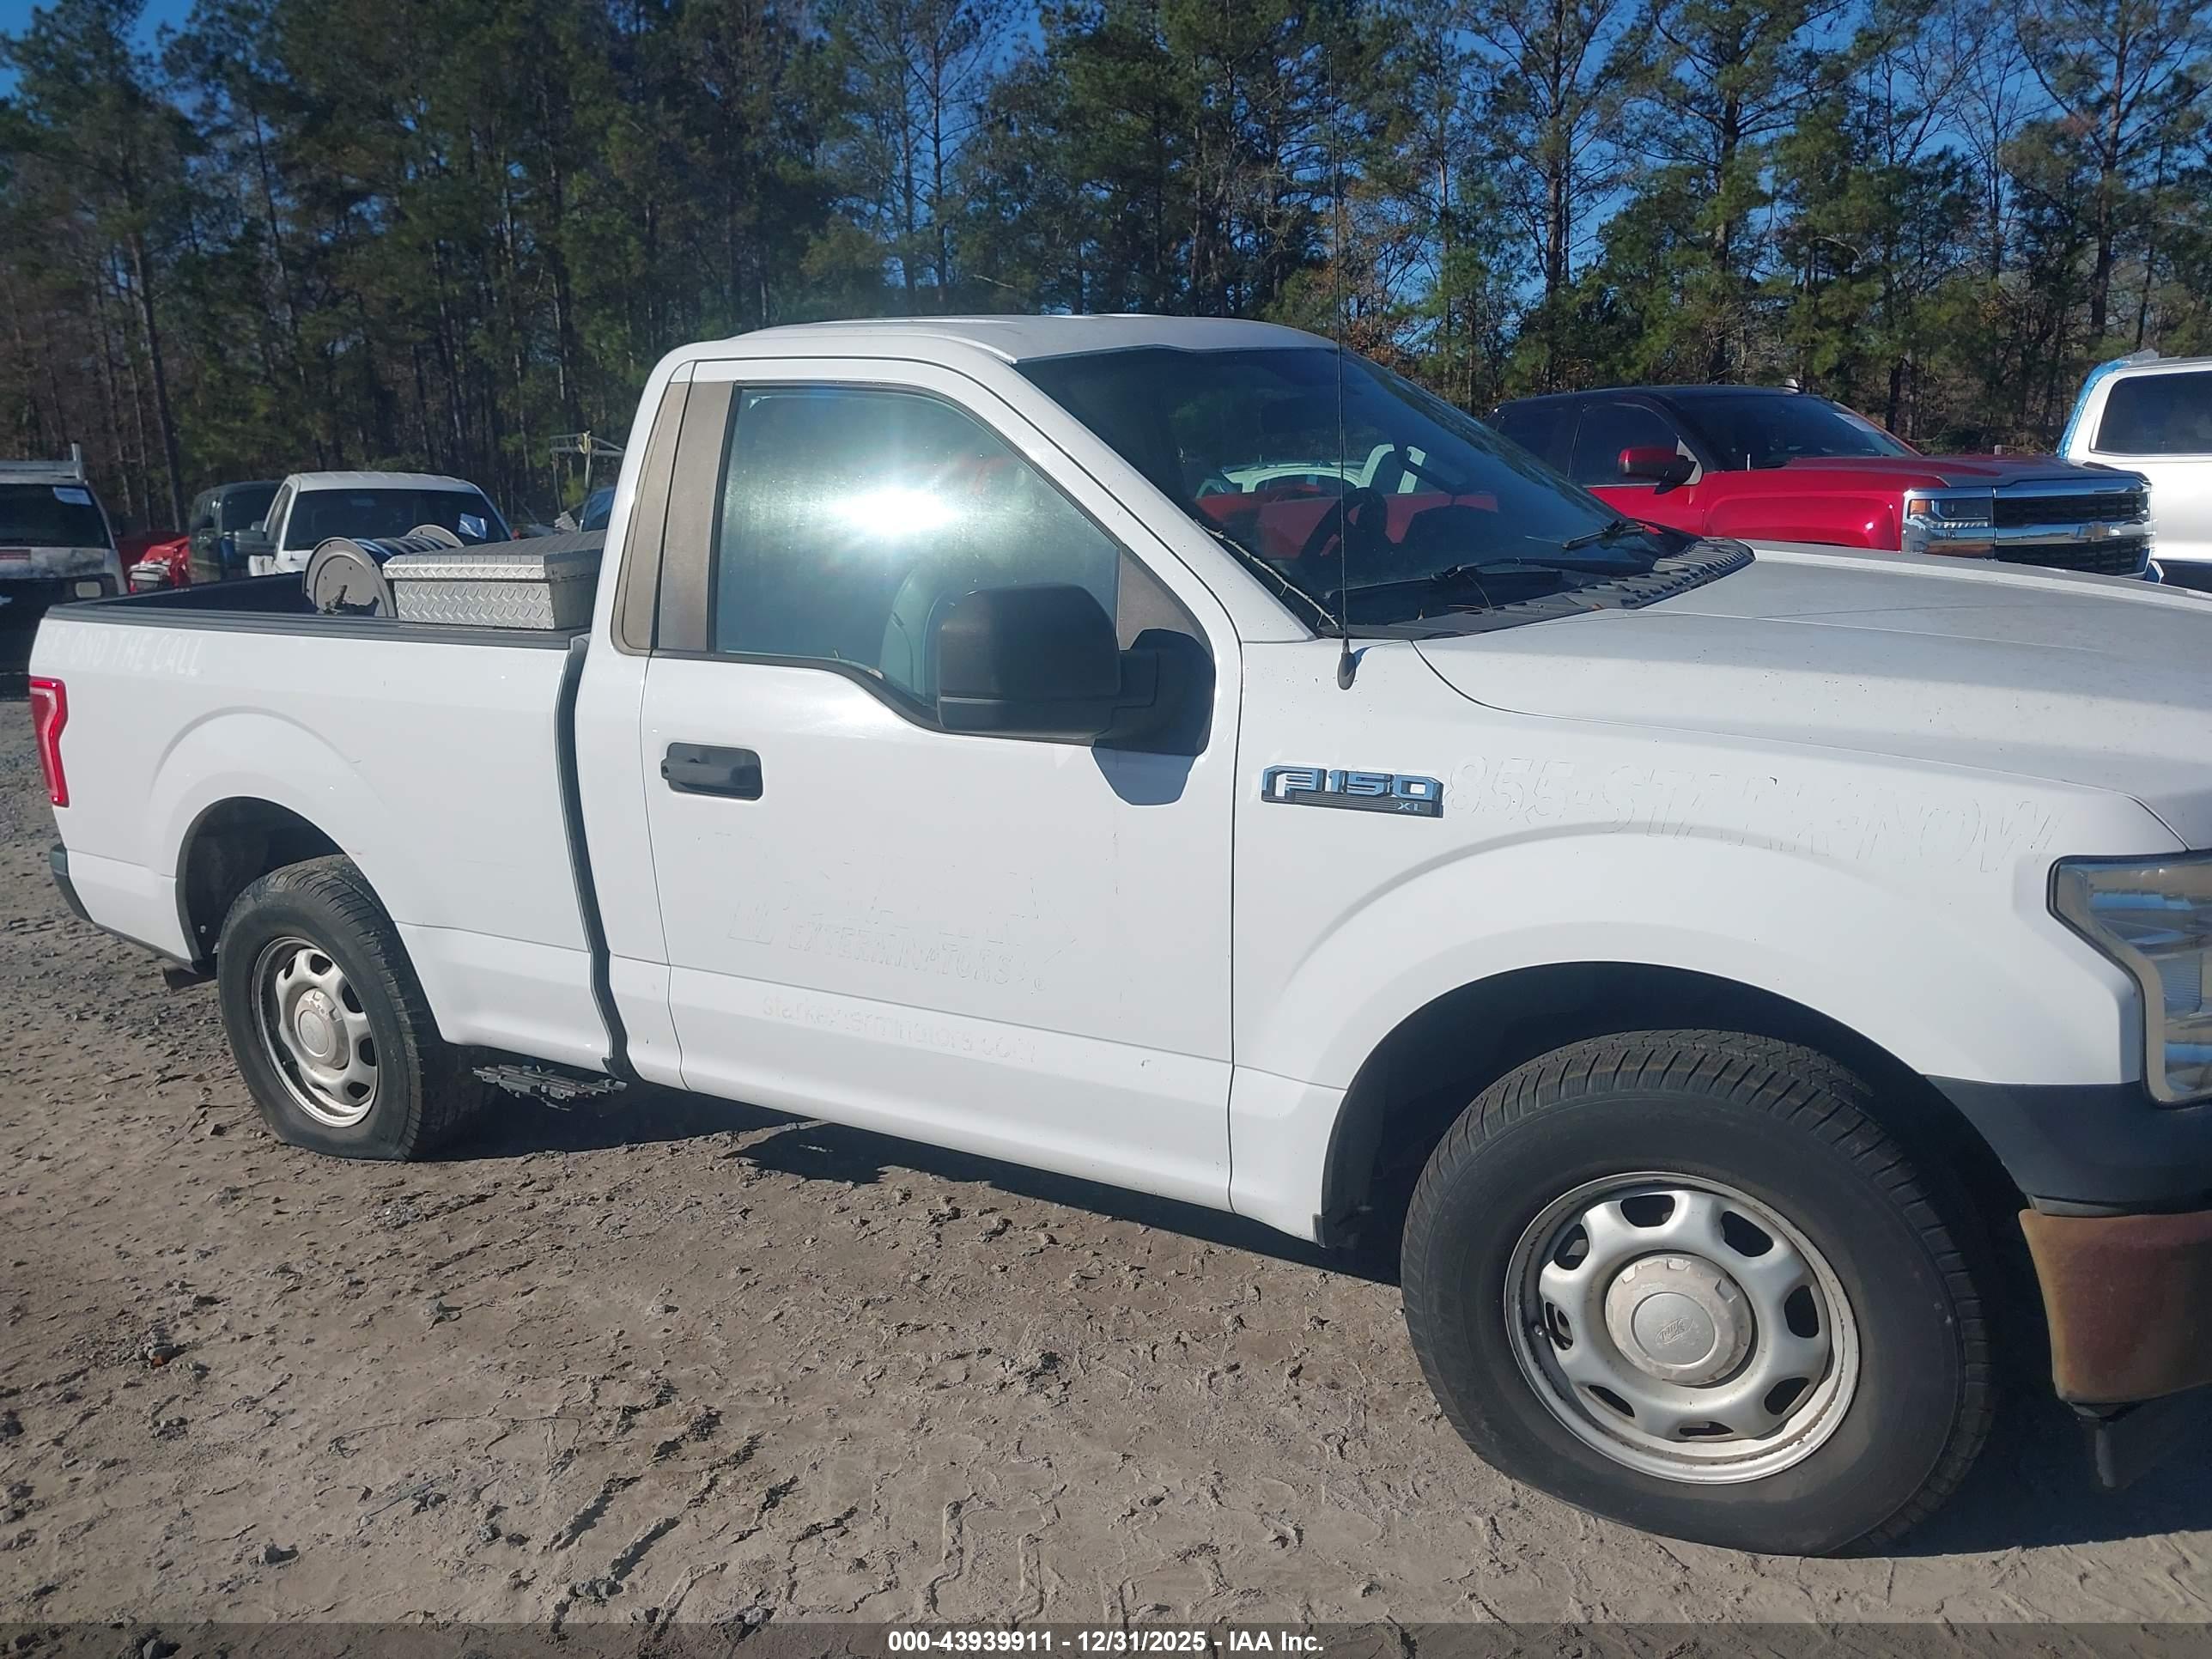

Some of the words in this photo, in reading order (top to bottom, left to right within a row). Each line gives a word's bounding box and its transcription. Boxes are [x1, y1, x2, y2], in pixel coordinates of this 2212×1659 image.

[40, 627, 110, 667] BEOND
[111, 630, 153, 672] THE
[151, 634, 204, 677] CALL
[1396, 801, 1424, 812] XL
[787, 920, 1014, 985] EXTERMINATORS
